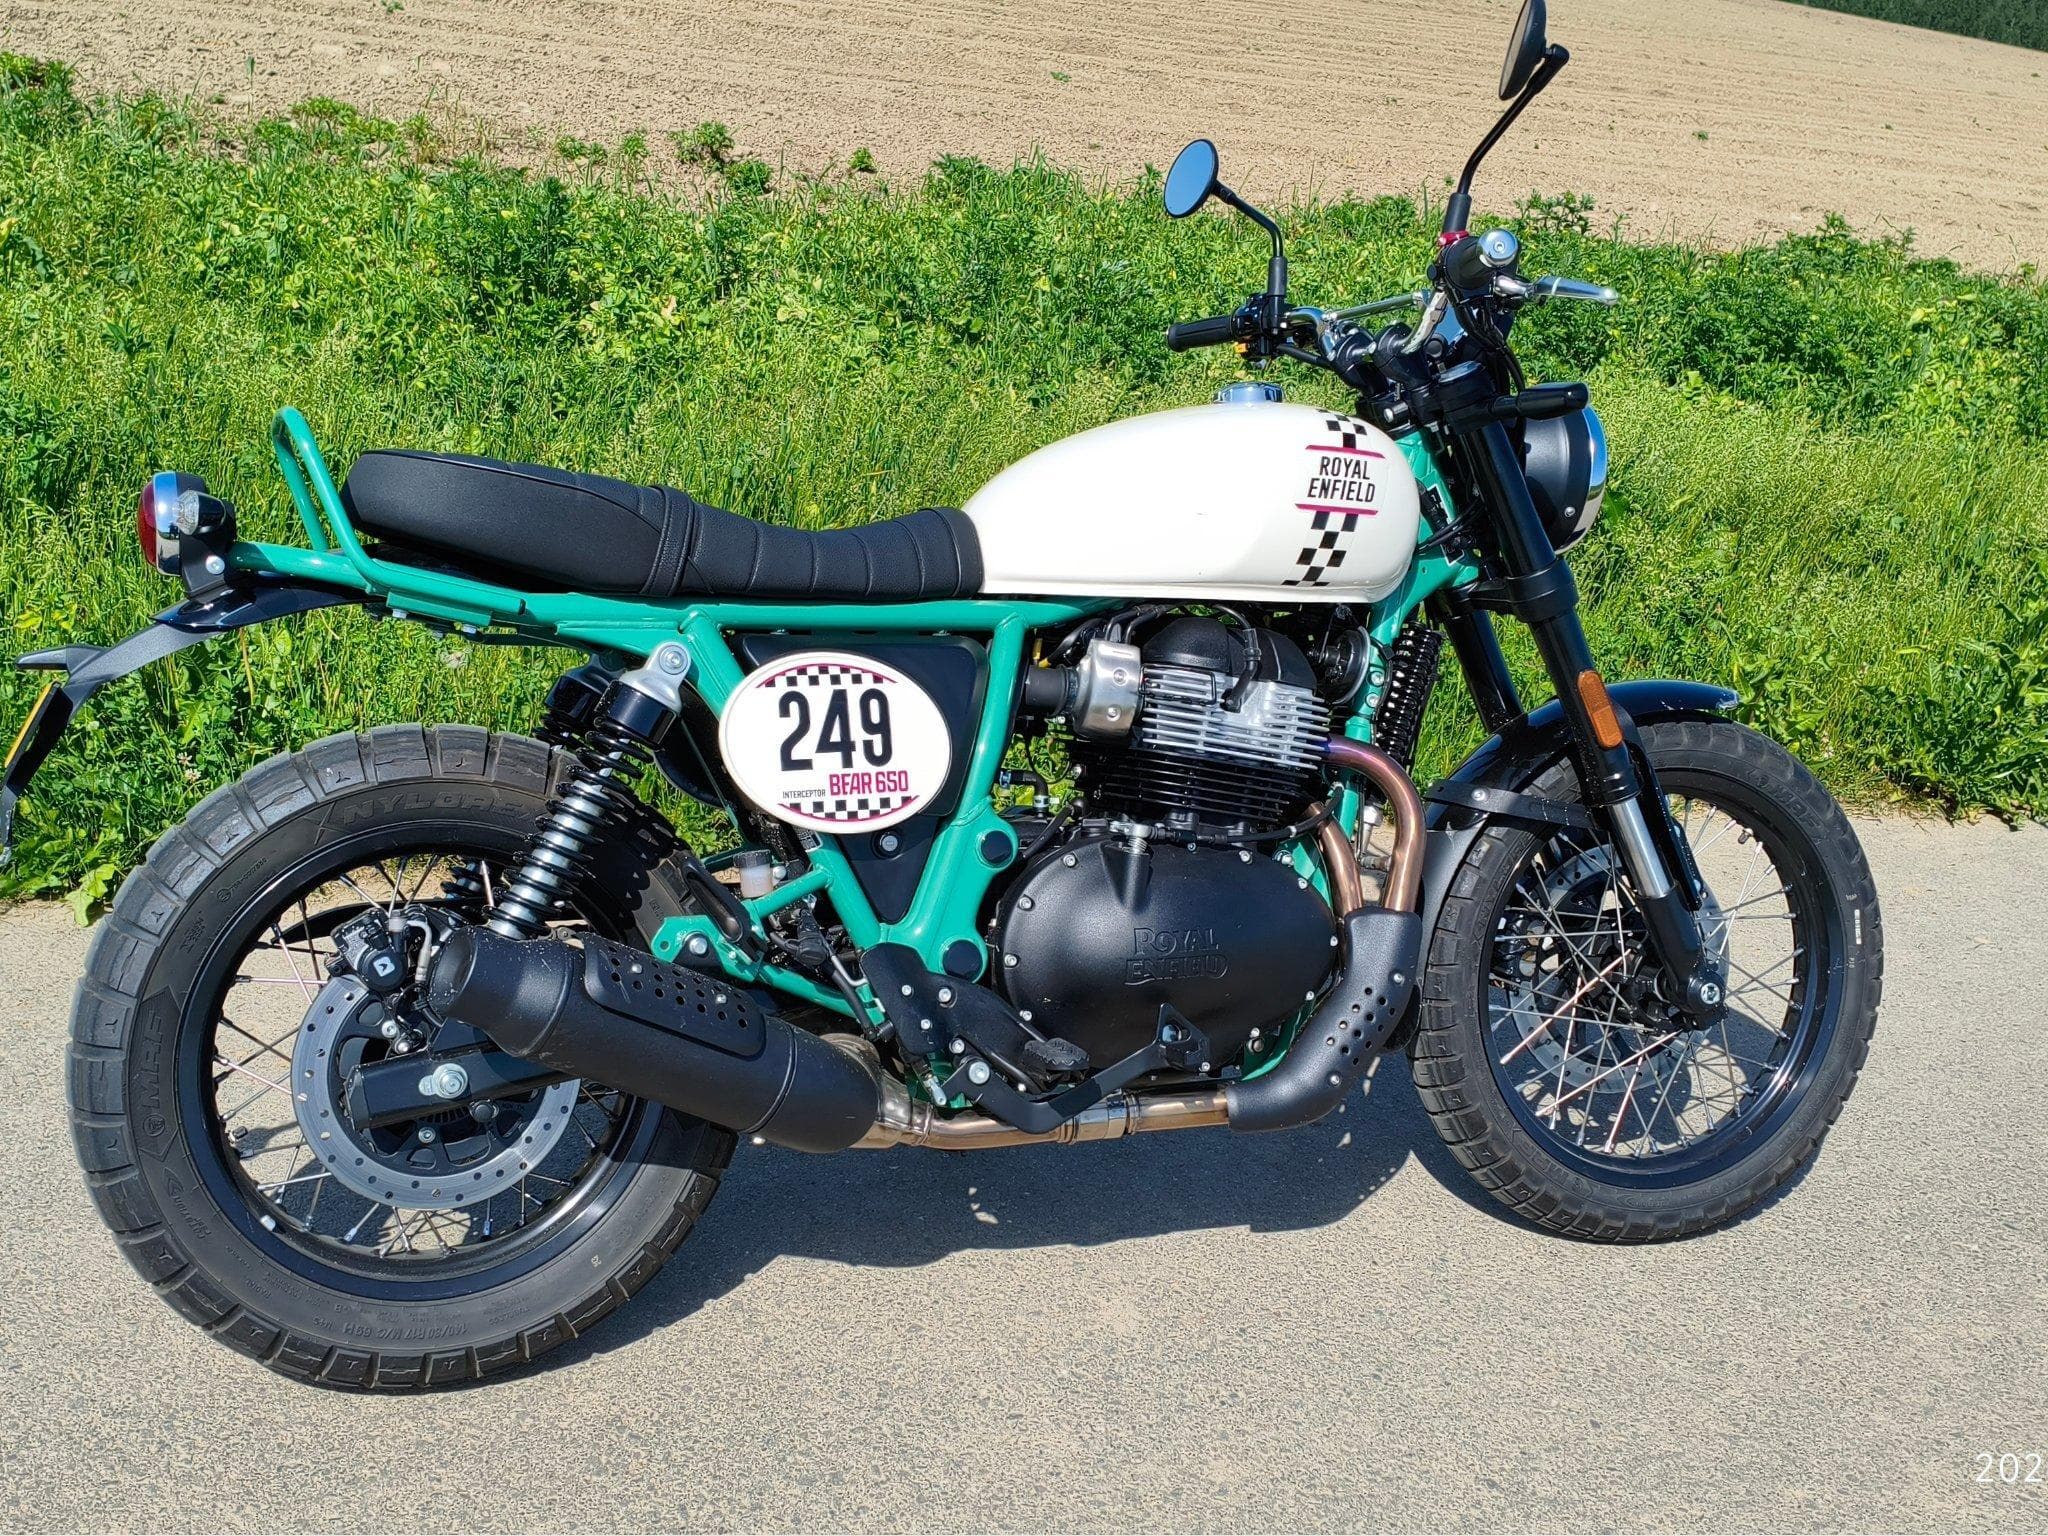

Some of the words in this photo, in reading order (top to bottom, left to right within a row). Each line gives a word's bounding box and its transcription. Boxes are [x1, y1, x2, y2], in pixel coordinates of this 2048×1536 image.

[1319, 456, 1370, 480] ROYAL
[1307, 478, 1376, 503] ENFIELD
[778, 688, 893, 771] 249
[783, 789, 826, 799] INTERCEPTOR
[829, 772, 872, 796] BEAR
[876, 770, 909, 793] 650
[1134, 927, 1220, 957] ROYAL
